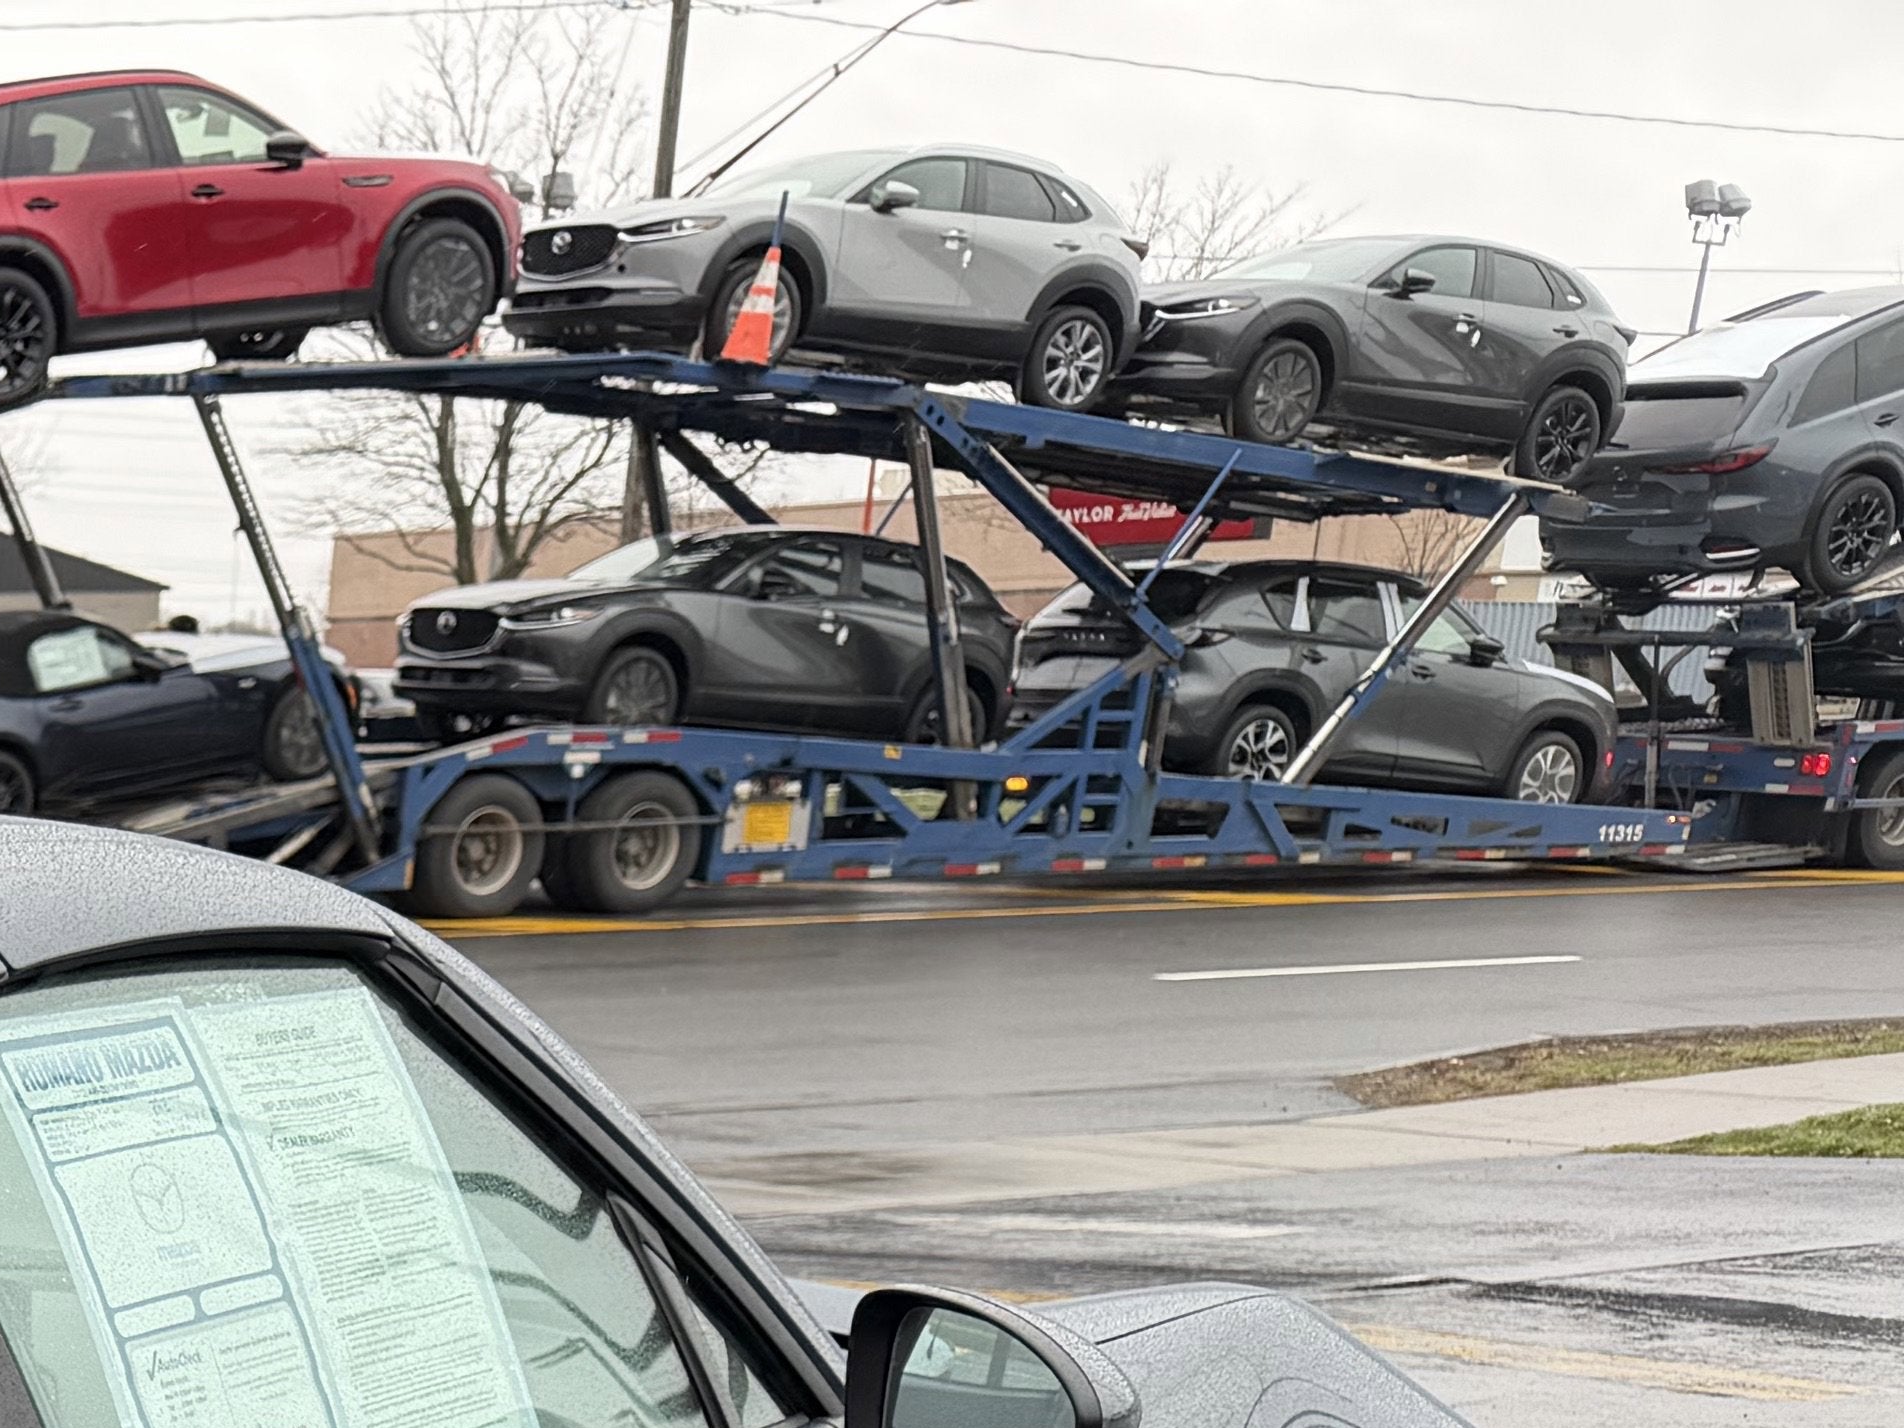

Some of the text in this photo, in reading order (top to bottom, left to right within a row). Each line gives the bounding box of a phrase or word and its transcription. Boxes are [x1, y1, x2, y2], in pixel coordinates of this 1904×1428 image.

[1057, 505, 1114, 524] AYLOR
[1598, 824, 1644, 842] 11315
[13, 1048, 106, 1093] ROMANO
[99, 1037, 182, 1079] MAZDA
